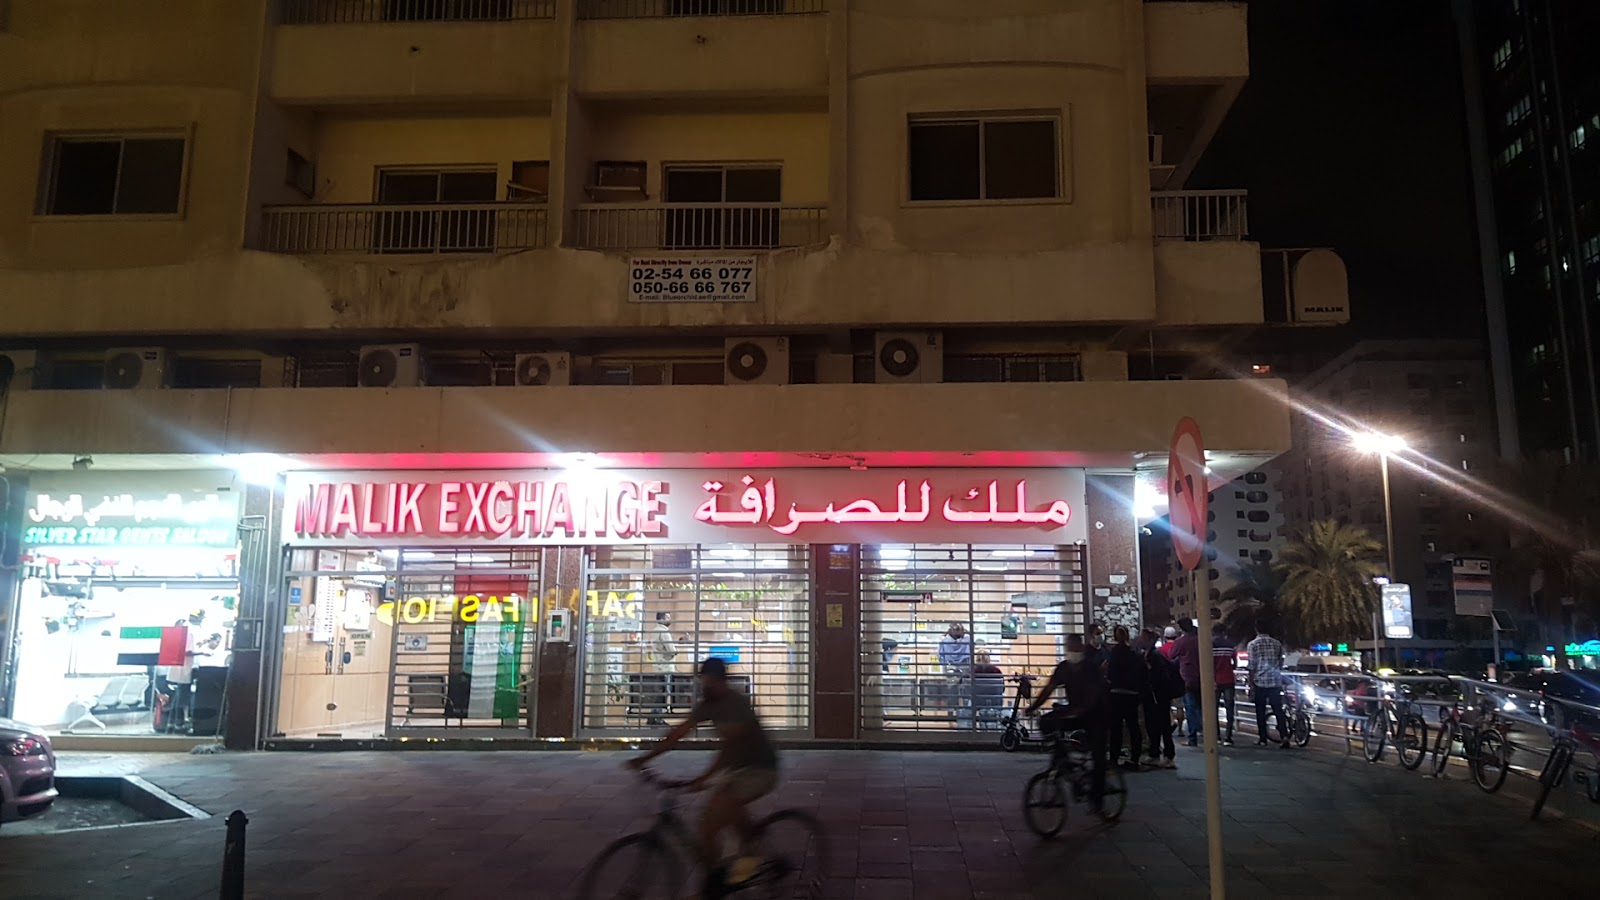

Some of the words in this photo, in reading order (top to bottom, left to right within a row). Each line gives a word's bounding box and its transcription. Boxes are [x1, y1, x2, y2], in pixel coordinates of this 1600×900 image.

[632, 268, 684, 280] 02-54
[690, 268, 712, 280] 66
[719, 268, 753, 280] 077
[633, 282, 689, 293] 050-66
[694, 282, 715, 293] 66
[720, 282, 751, 293] 767
[294, 482, 428, 535] MALIK
[438, 480, 668, 536] EXCHANGE
[693, 474, 931, 535] للصرافة
[942, 479, 1072, 526] ملك
[25, 527, 77, 545] SILVER
[77, 527, 117, 545] STAR
[118, 527, 170, 545] GENTS
